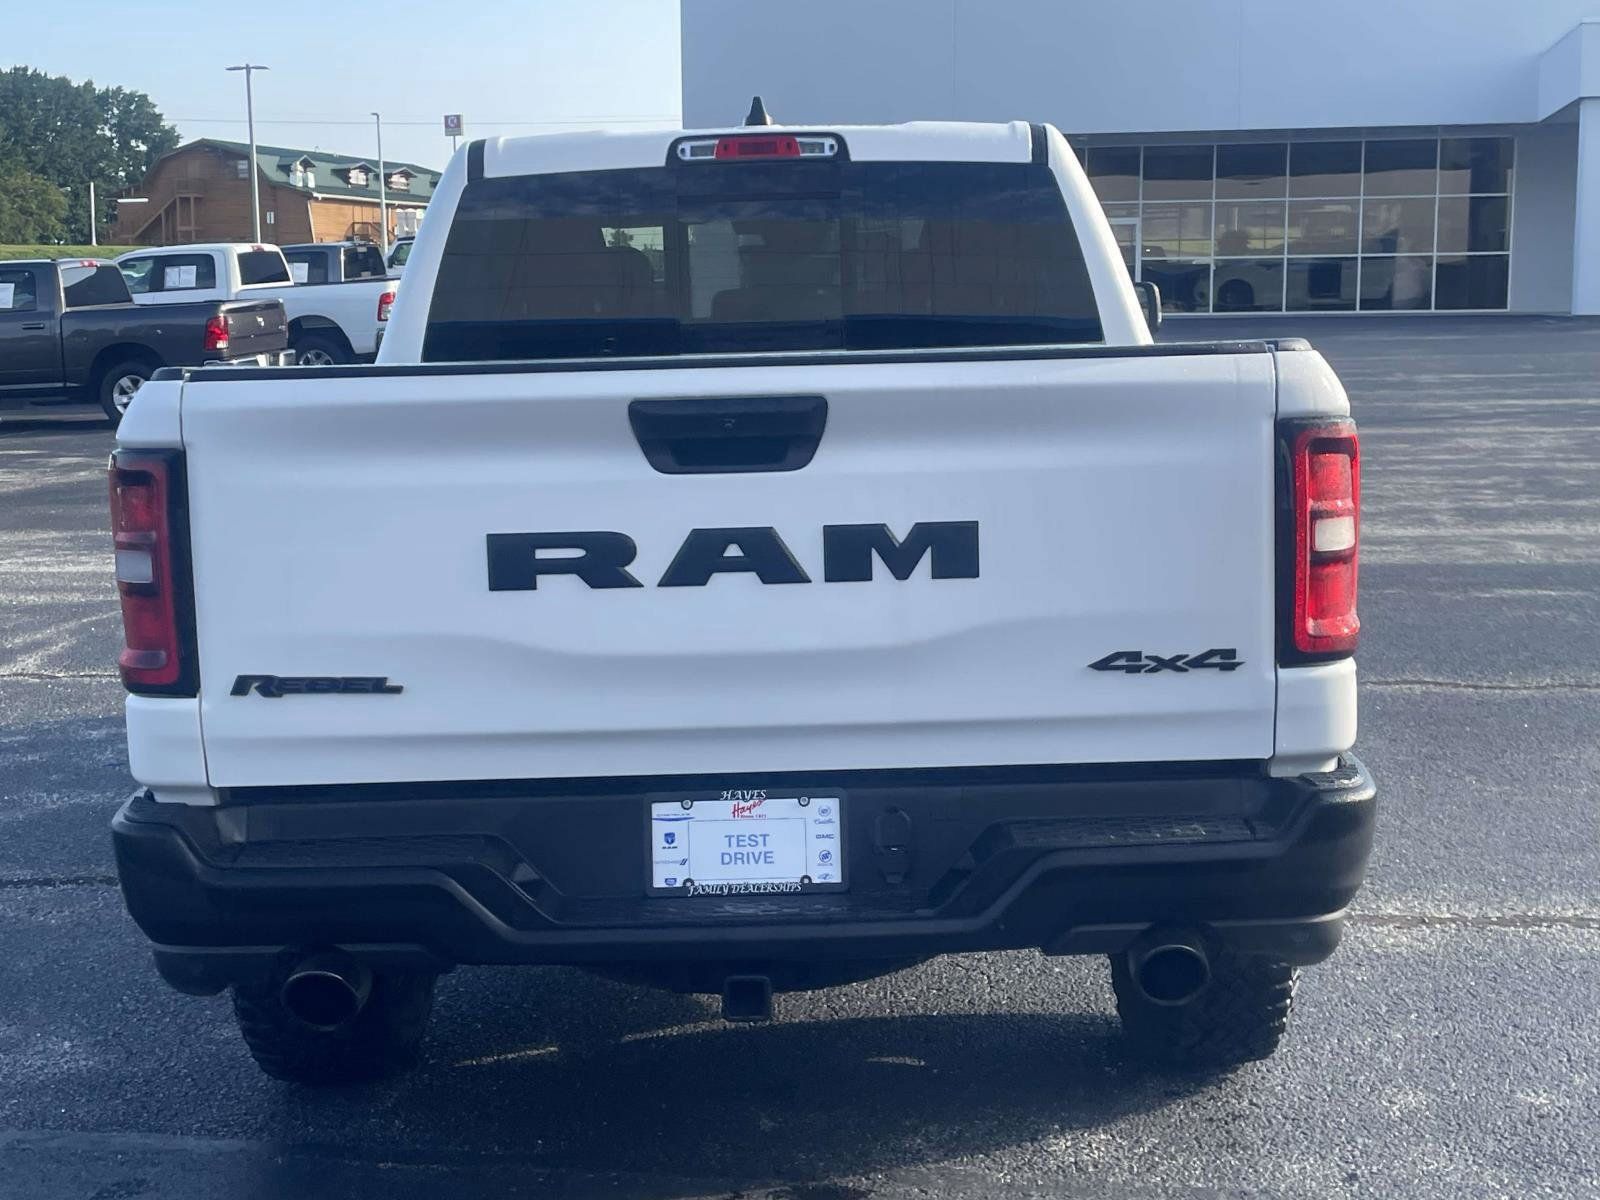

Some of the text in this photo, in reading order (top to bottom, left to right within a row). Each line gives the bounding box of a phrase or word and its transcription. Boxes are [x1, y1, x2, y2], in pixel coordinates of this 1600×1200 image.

[486, 520, 980, 591] RAM
[1087, 648, 1246, 674] 4x4
[720, 789, 767, 801] HAYES
[732, 799, 767, 819] Hayes
[724, 833, 770, 848] TEST
[720, 851, 775, 866] DRIVE
[688, 882, 802, 897] FAMILY DEALERSHIPS
